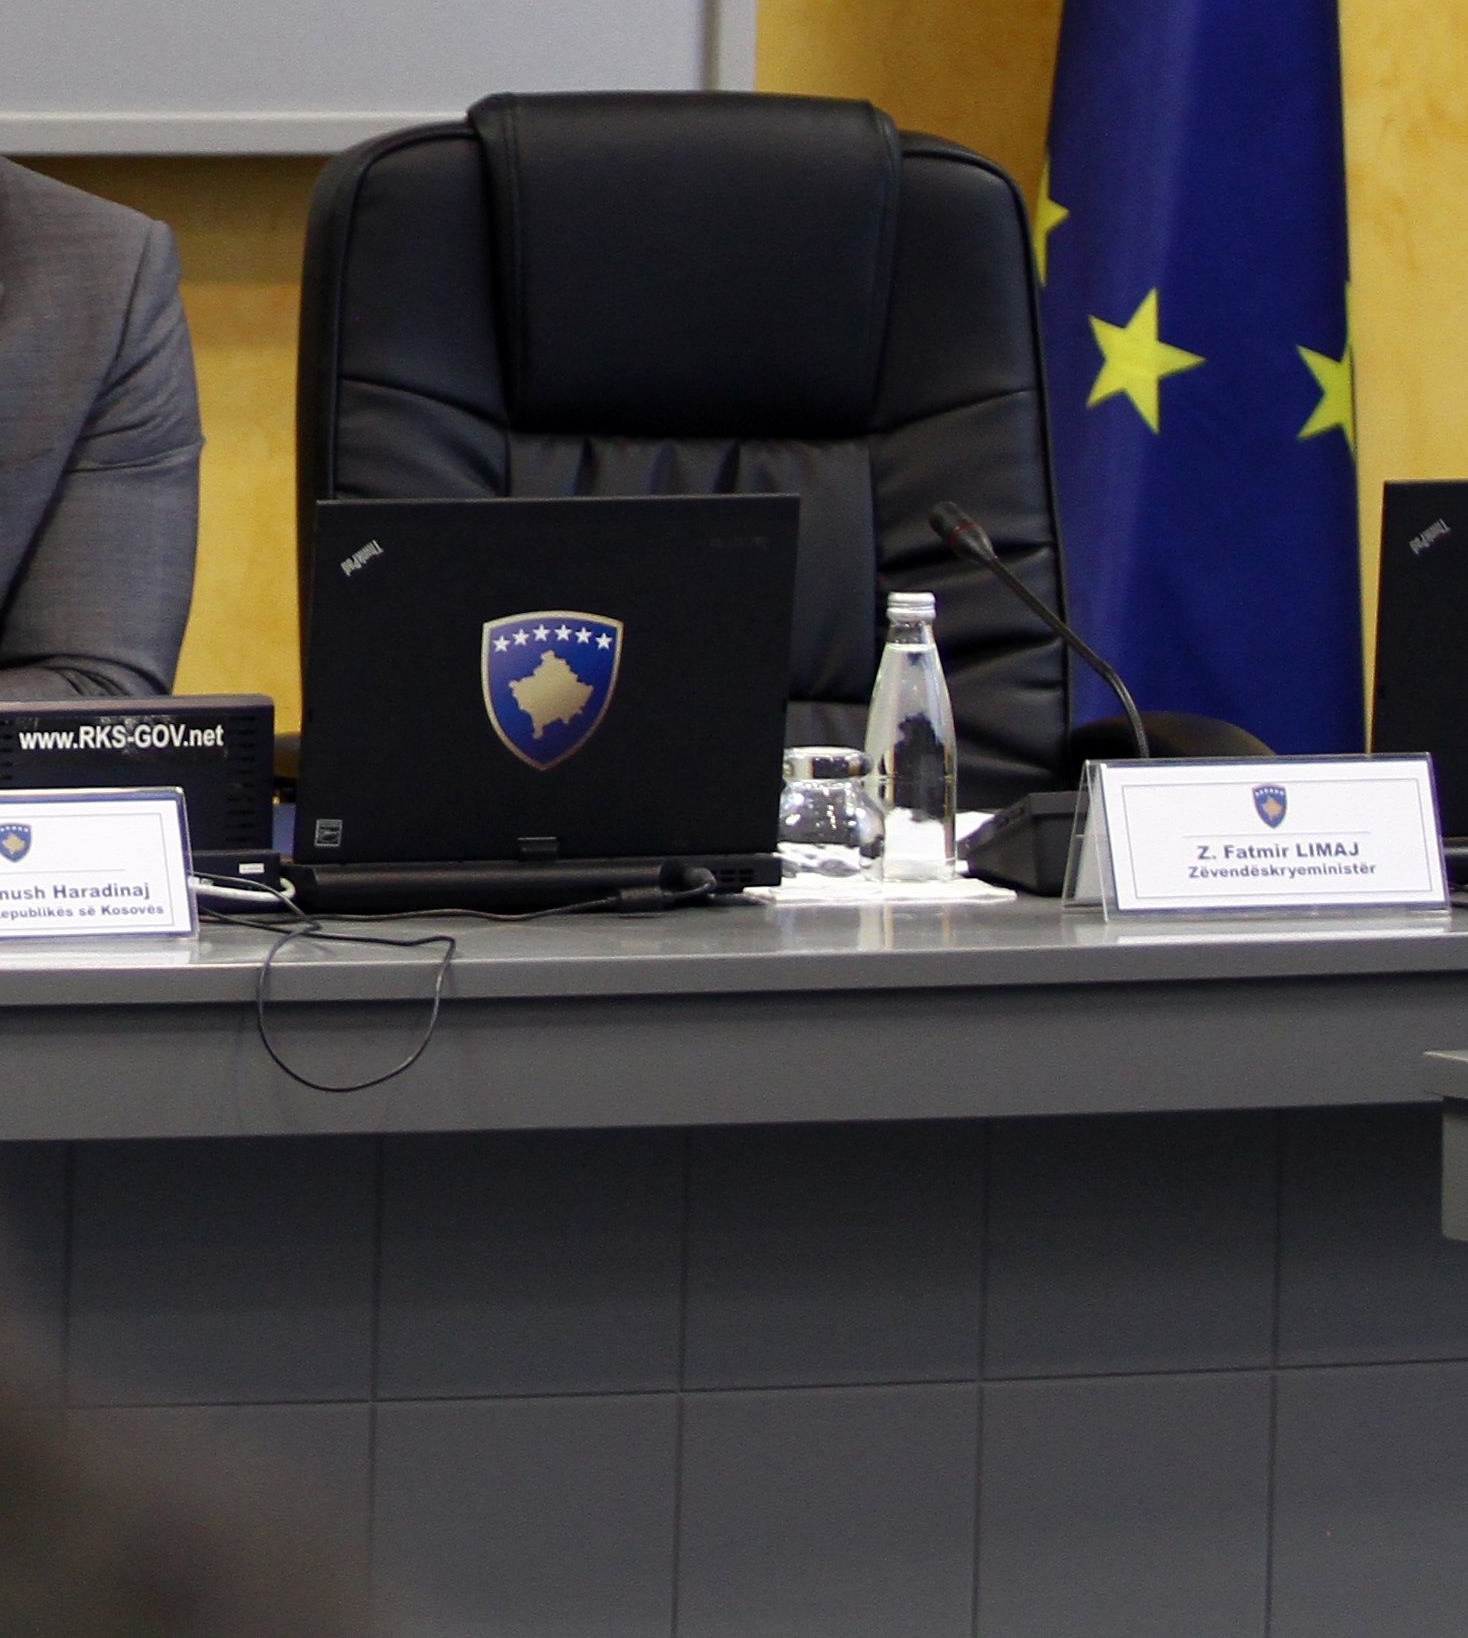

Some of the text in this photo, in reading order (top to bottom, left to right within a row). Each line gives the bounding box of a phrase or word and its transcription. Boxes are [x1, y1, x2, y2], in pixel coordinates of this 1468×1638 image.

[18, 723, 225, 750] www.RKS-GOV.net
[1196, 841, 1361, 860] Z. Fatmir LIMAJ
[1188, 862, 1376, 880] Zëvendëskryeministër
[53, 881, 150, 900] Haradinaj
[78, 904, 96, 916] së
[101, 903, 164, 915] Kosovës
